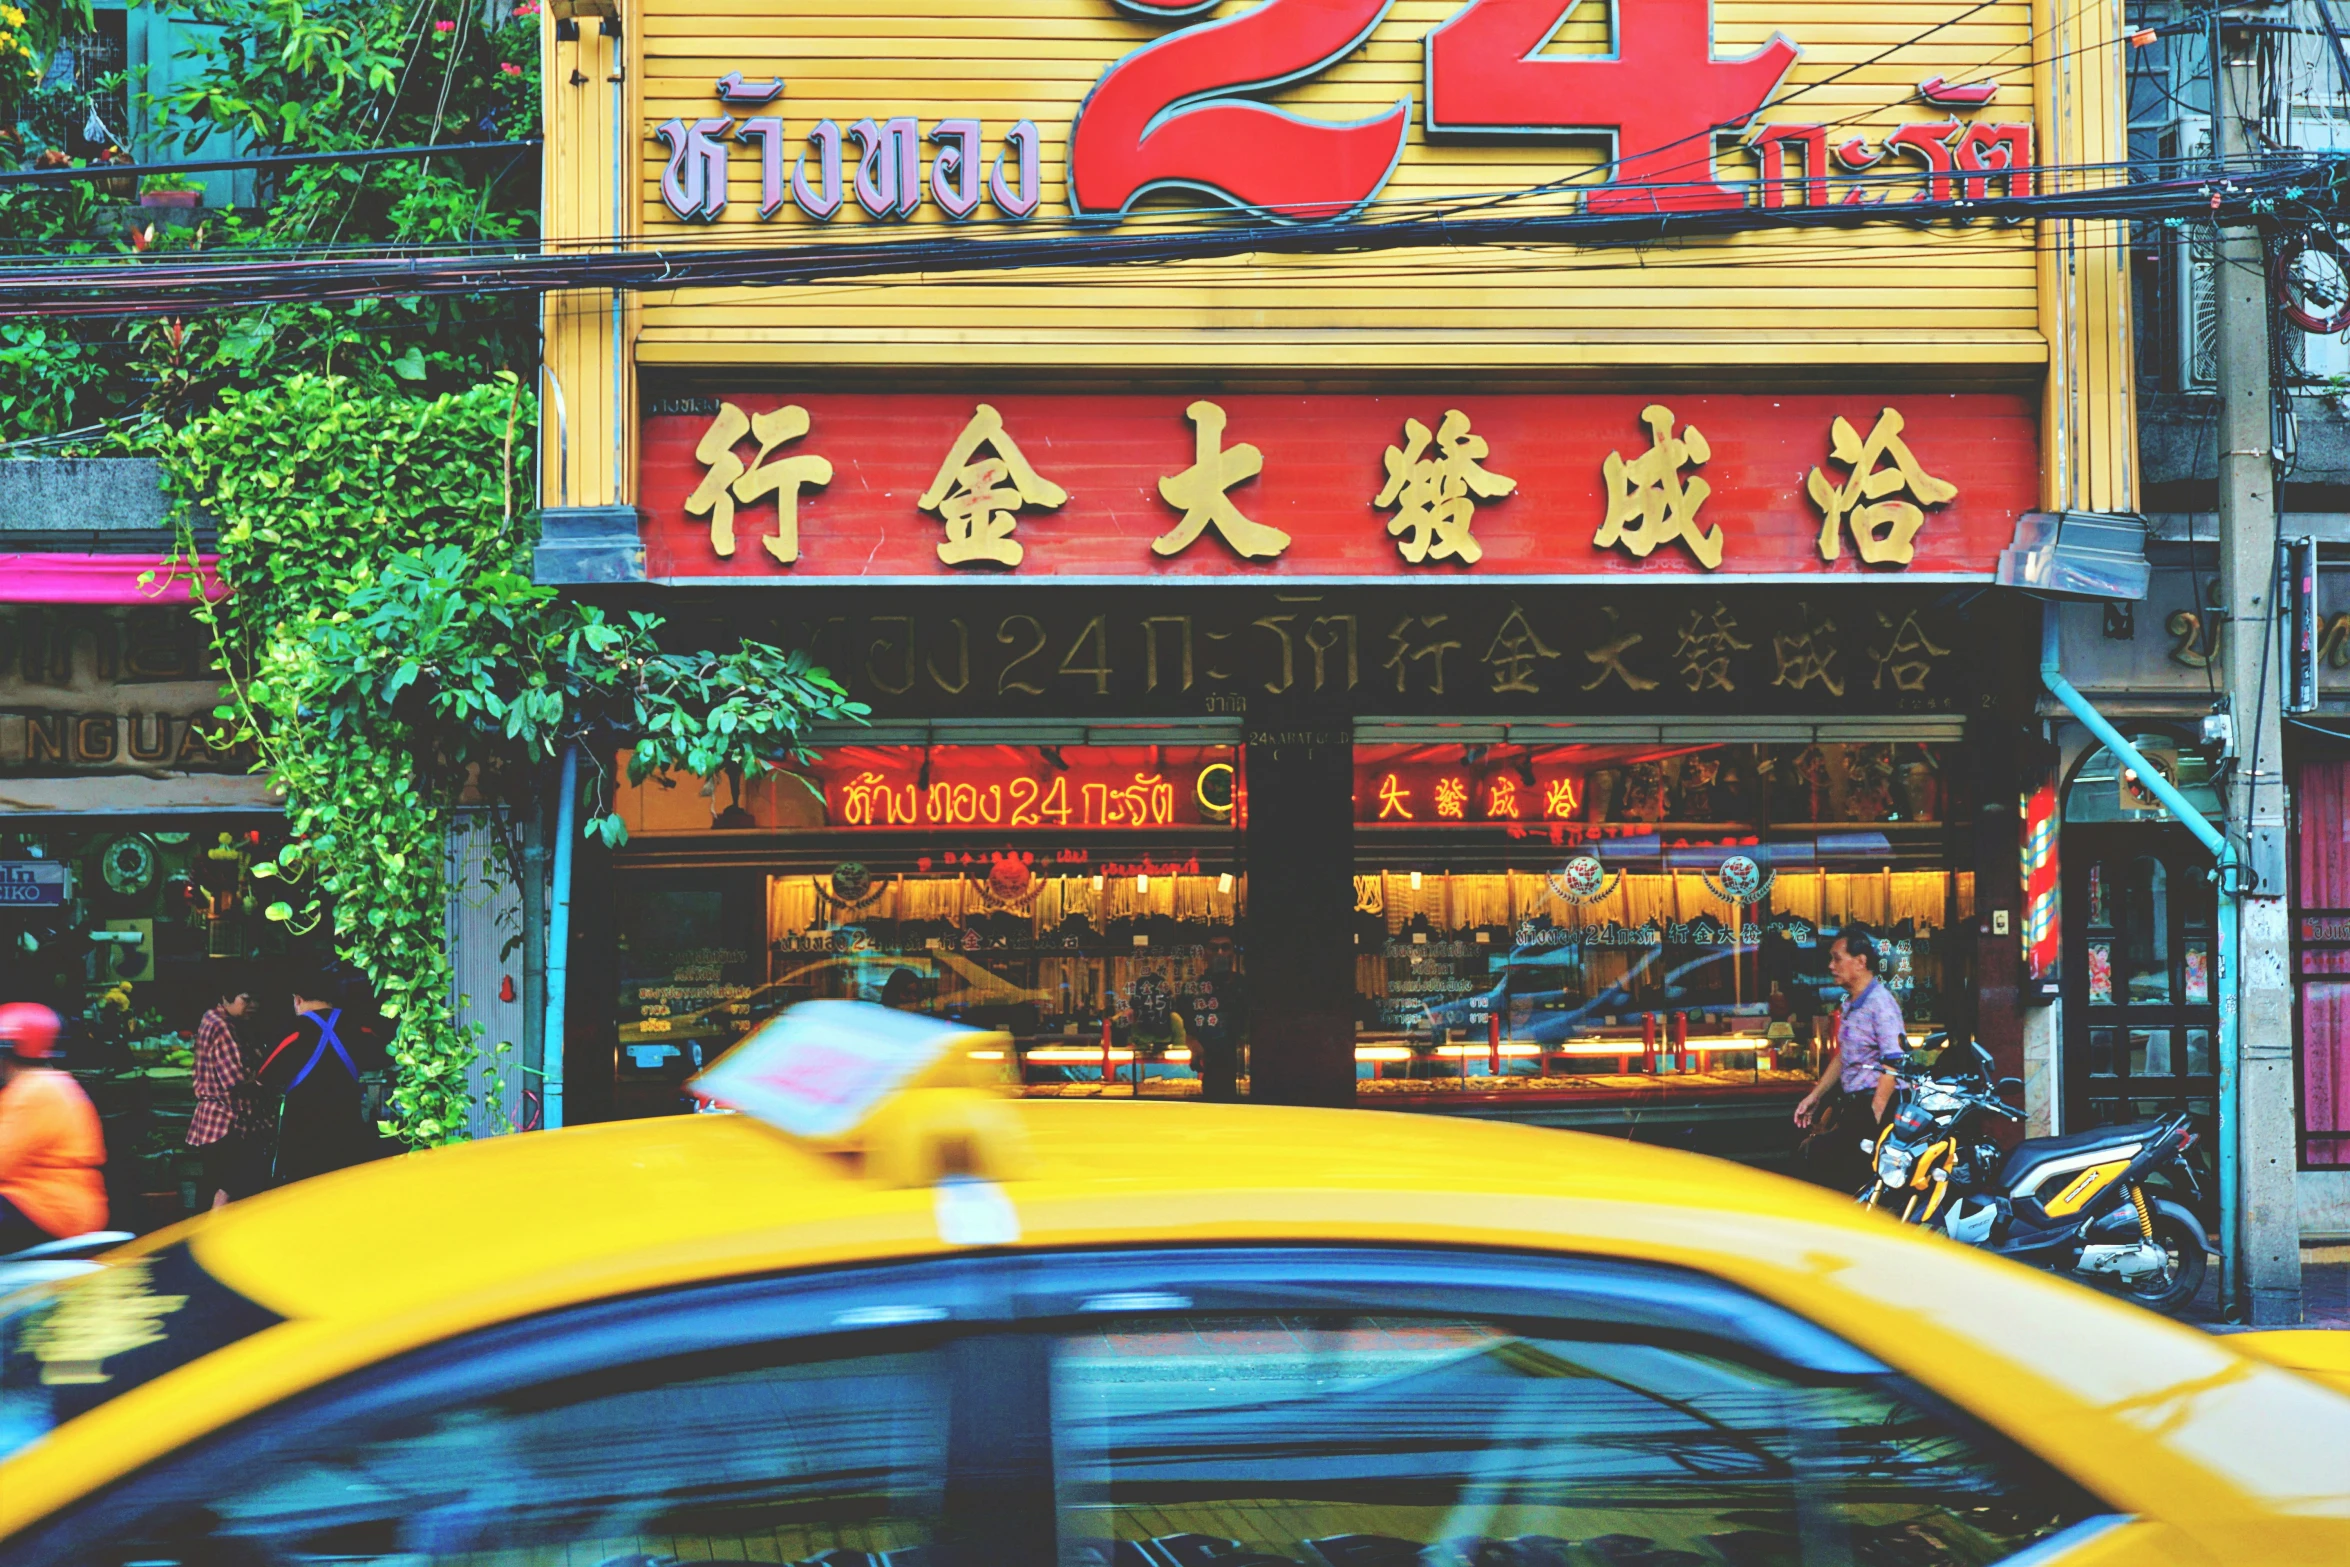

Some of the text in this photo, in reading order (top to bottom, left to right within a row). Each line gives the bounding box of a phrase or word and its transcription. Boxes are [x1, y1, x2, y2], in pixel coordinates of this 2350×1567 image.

[655, 70, 1041, 222] ห้างทอง
[1066, 0, 1798, 225] 24
[996, 614, 1114, 695] 24
[1140, 594, 1360, 696] กะรัต
[1009, 776, 1072, 827] 24
[1081, 772, 1174, 827] กะรัต
[0, 884, 41, 901] IKO
[1585, 923, 1615, 946] 24
